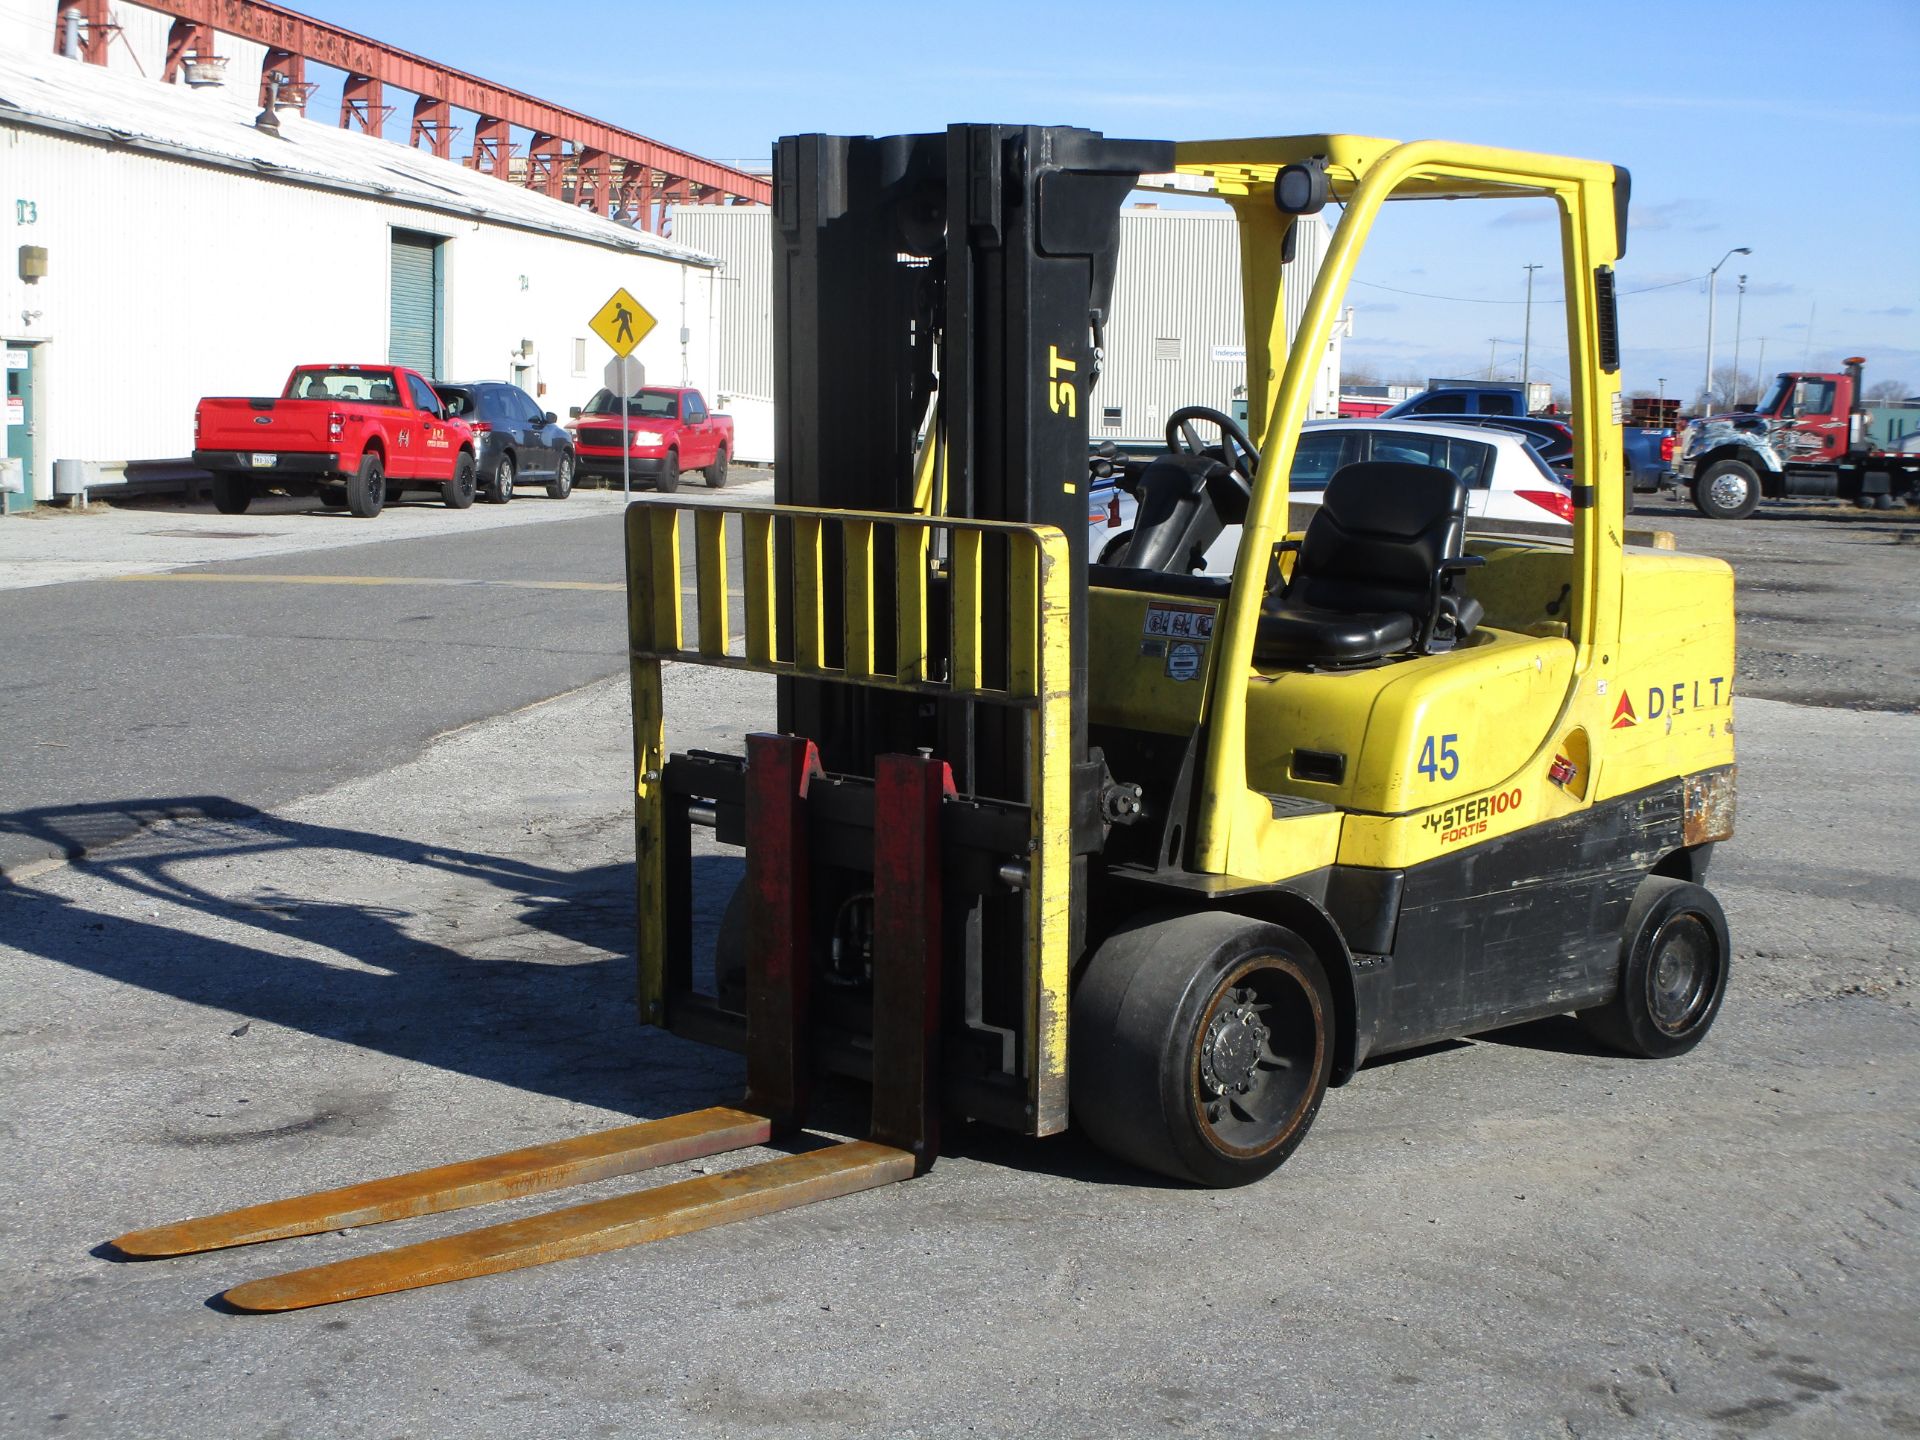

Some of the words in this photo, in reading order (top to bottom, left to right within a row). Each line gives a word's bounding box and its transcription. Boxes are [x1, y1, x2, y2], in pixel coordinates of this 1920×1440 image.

[16, 199, 38, 225] T3
[1417, 733, 1459, 782] 45
[1440, 820, 1488, 845] FORTIS
